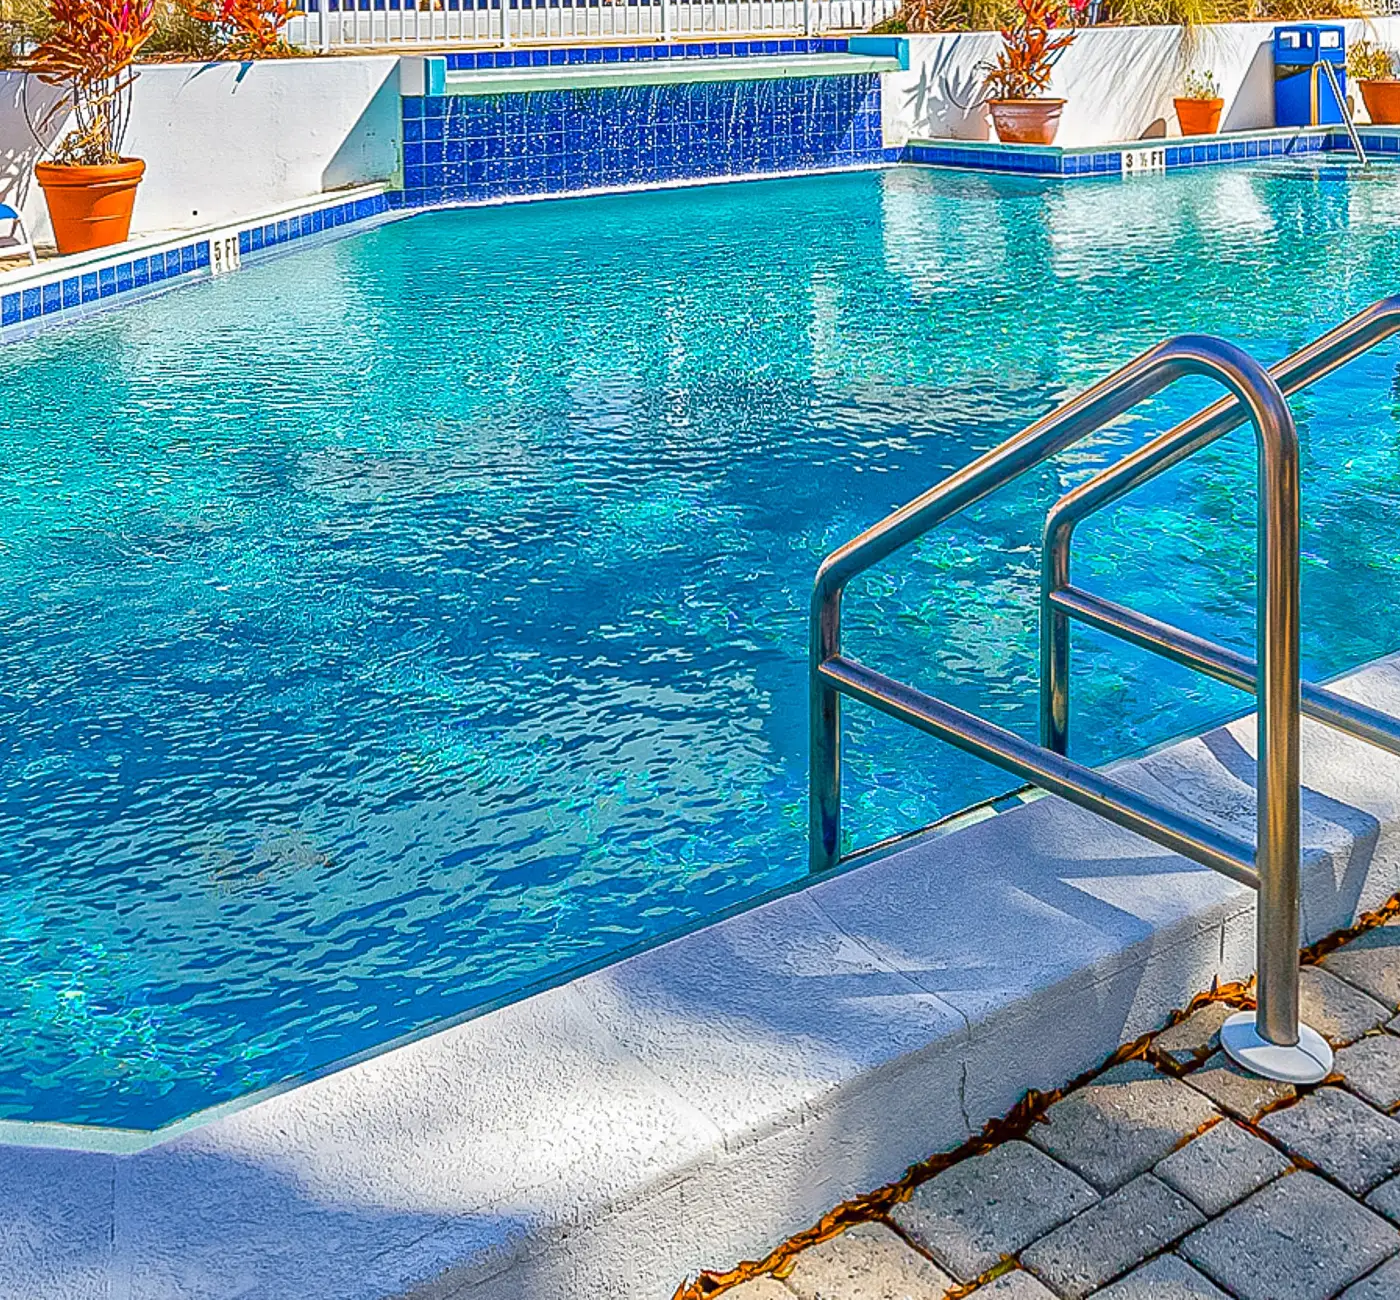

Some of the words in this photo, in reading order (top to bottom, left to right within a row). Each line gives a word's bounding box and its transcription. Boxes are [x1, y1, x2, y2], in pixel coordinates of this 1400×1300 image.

[1126, 153, 1133, 168] 3
[1151, 151, 1164, 166] FT
[214, 241, 221, 261] 5
[225, 237, 237, 258] FT
